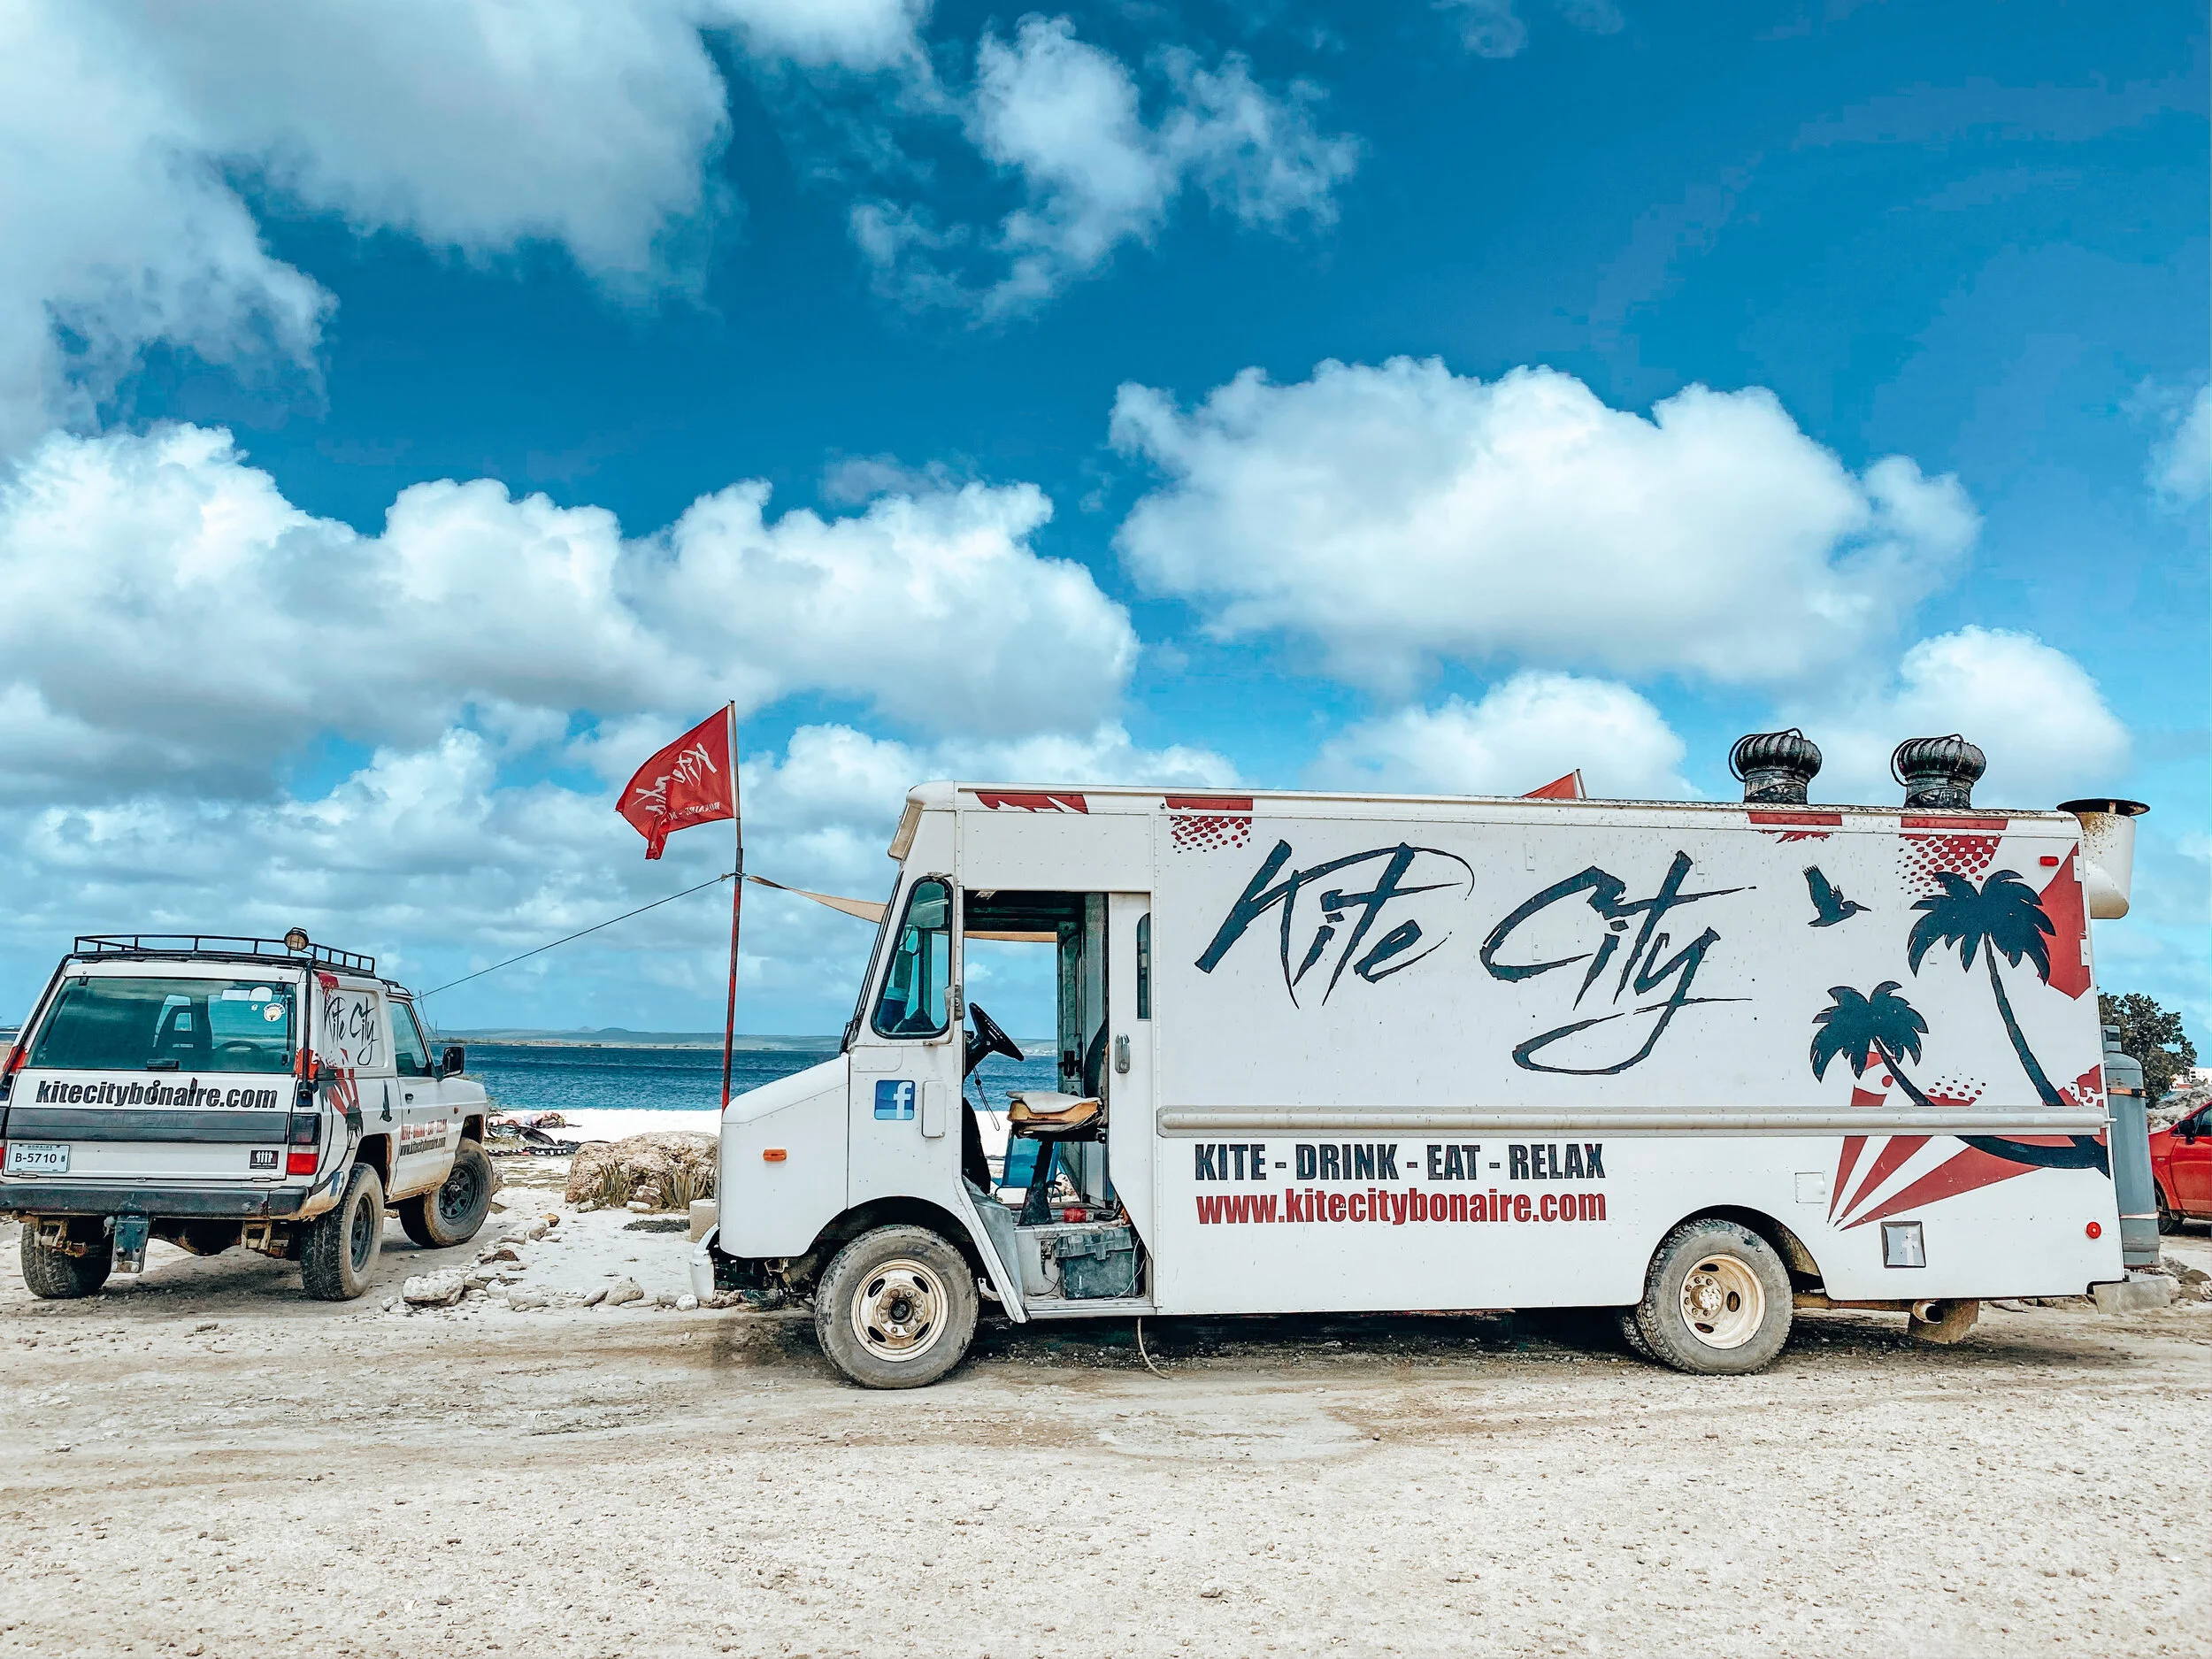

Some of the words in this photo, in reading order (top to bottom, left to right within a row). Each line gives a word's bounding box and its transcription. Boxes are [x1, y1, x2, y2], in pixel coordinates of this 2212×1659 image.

[1194, 840, 1475, 1010] Kite
[1480, 850, 1757, 1075] City
[324, 996, 347, 1045] Kite
[349, 996, 380, 1066] City
[35, 1079, 278, 1109] kitecitybonaire.com
[15, 1153, 57, 1164] B-5710
[1194, 1144, 1266, 1180] KITE
[1295, 1143, 1399, 1180] DRINK
[1426, 1144, 1480, 1180] EAT
[1509, 1143, 1606, 1180] RELAX
[1195, 1188, 1607, 1225] www.kitecitybonaire.com
